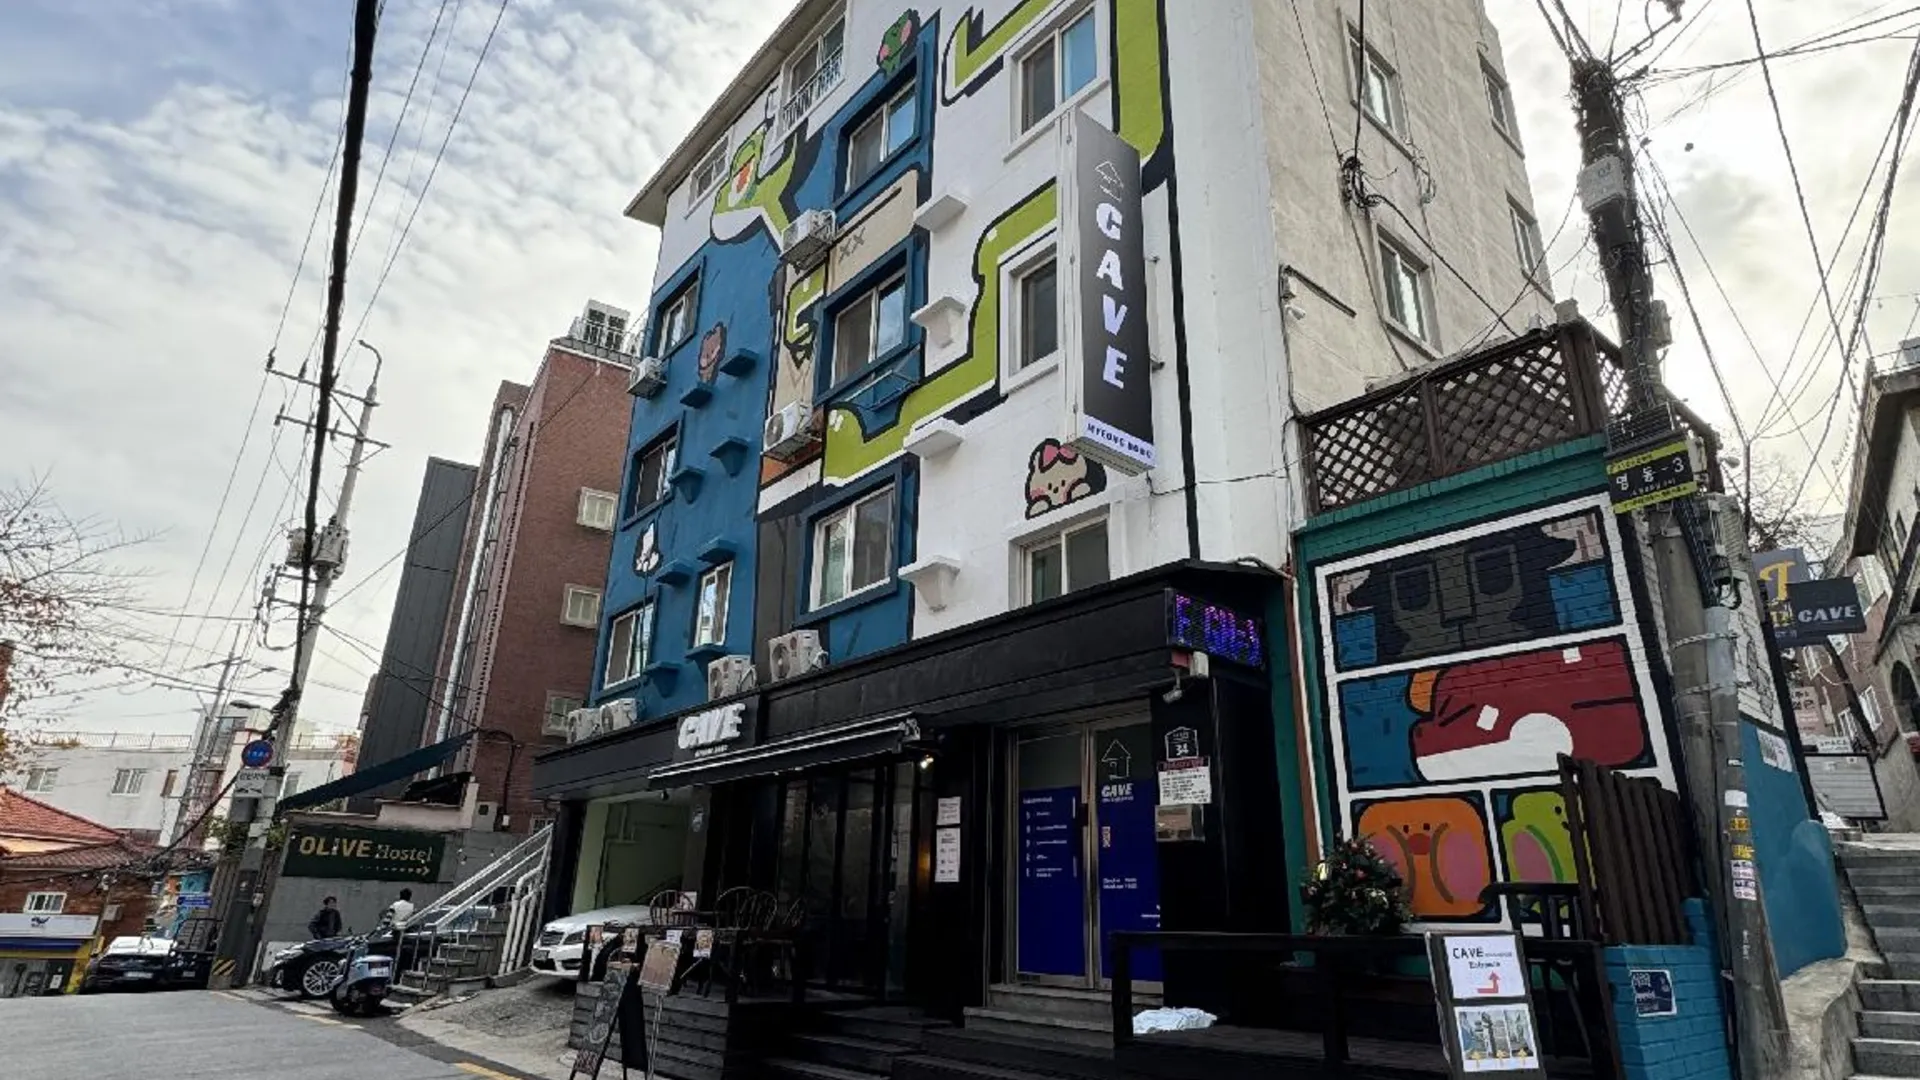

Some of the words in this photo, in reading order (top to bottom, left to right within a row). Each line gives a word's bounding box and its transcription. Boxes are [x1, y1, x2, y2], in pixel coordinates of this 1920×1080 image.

[1095, 202, 1128, 390] CAVE
[1087, 423, 1126, 448] MYEONG
[1127, 441, 1154, 459] DONG
[1798, 604, 1857, 623] CAVE
[678, 703, 746, 749] CAVE
[1175, 743, 1190, 756] 34
[1101, 782, 1135, 798] CAVE
[299, 835, 373, 858] OLIVE
[374, 843, 433, 862] Hostel
[1452, 946, 1485, 960] CAVE
